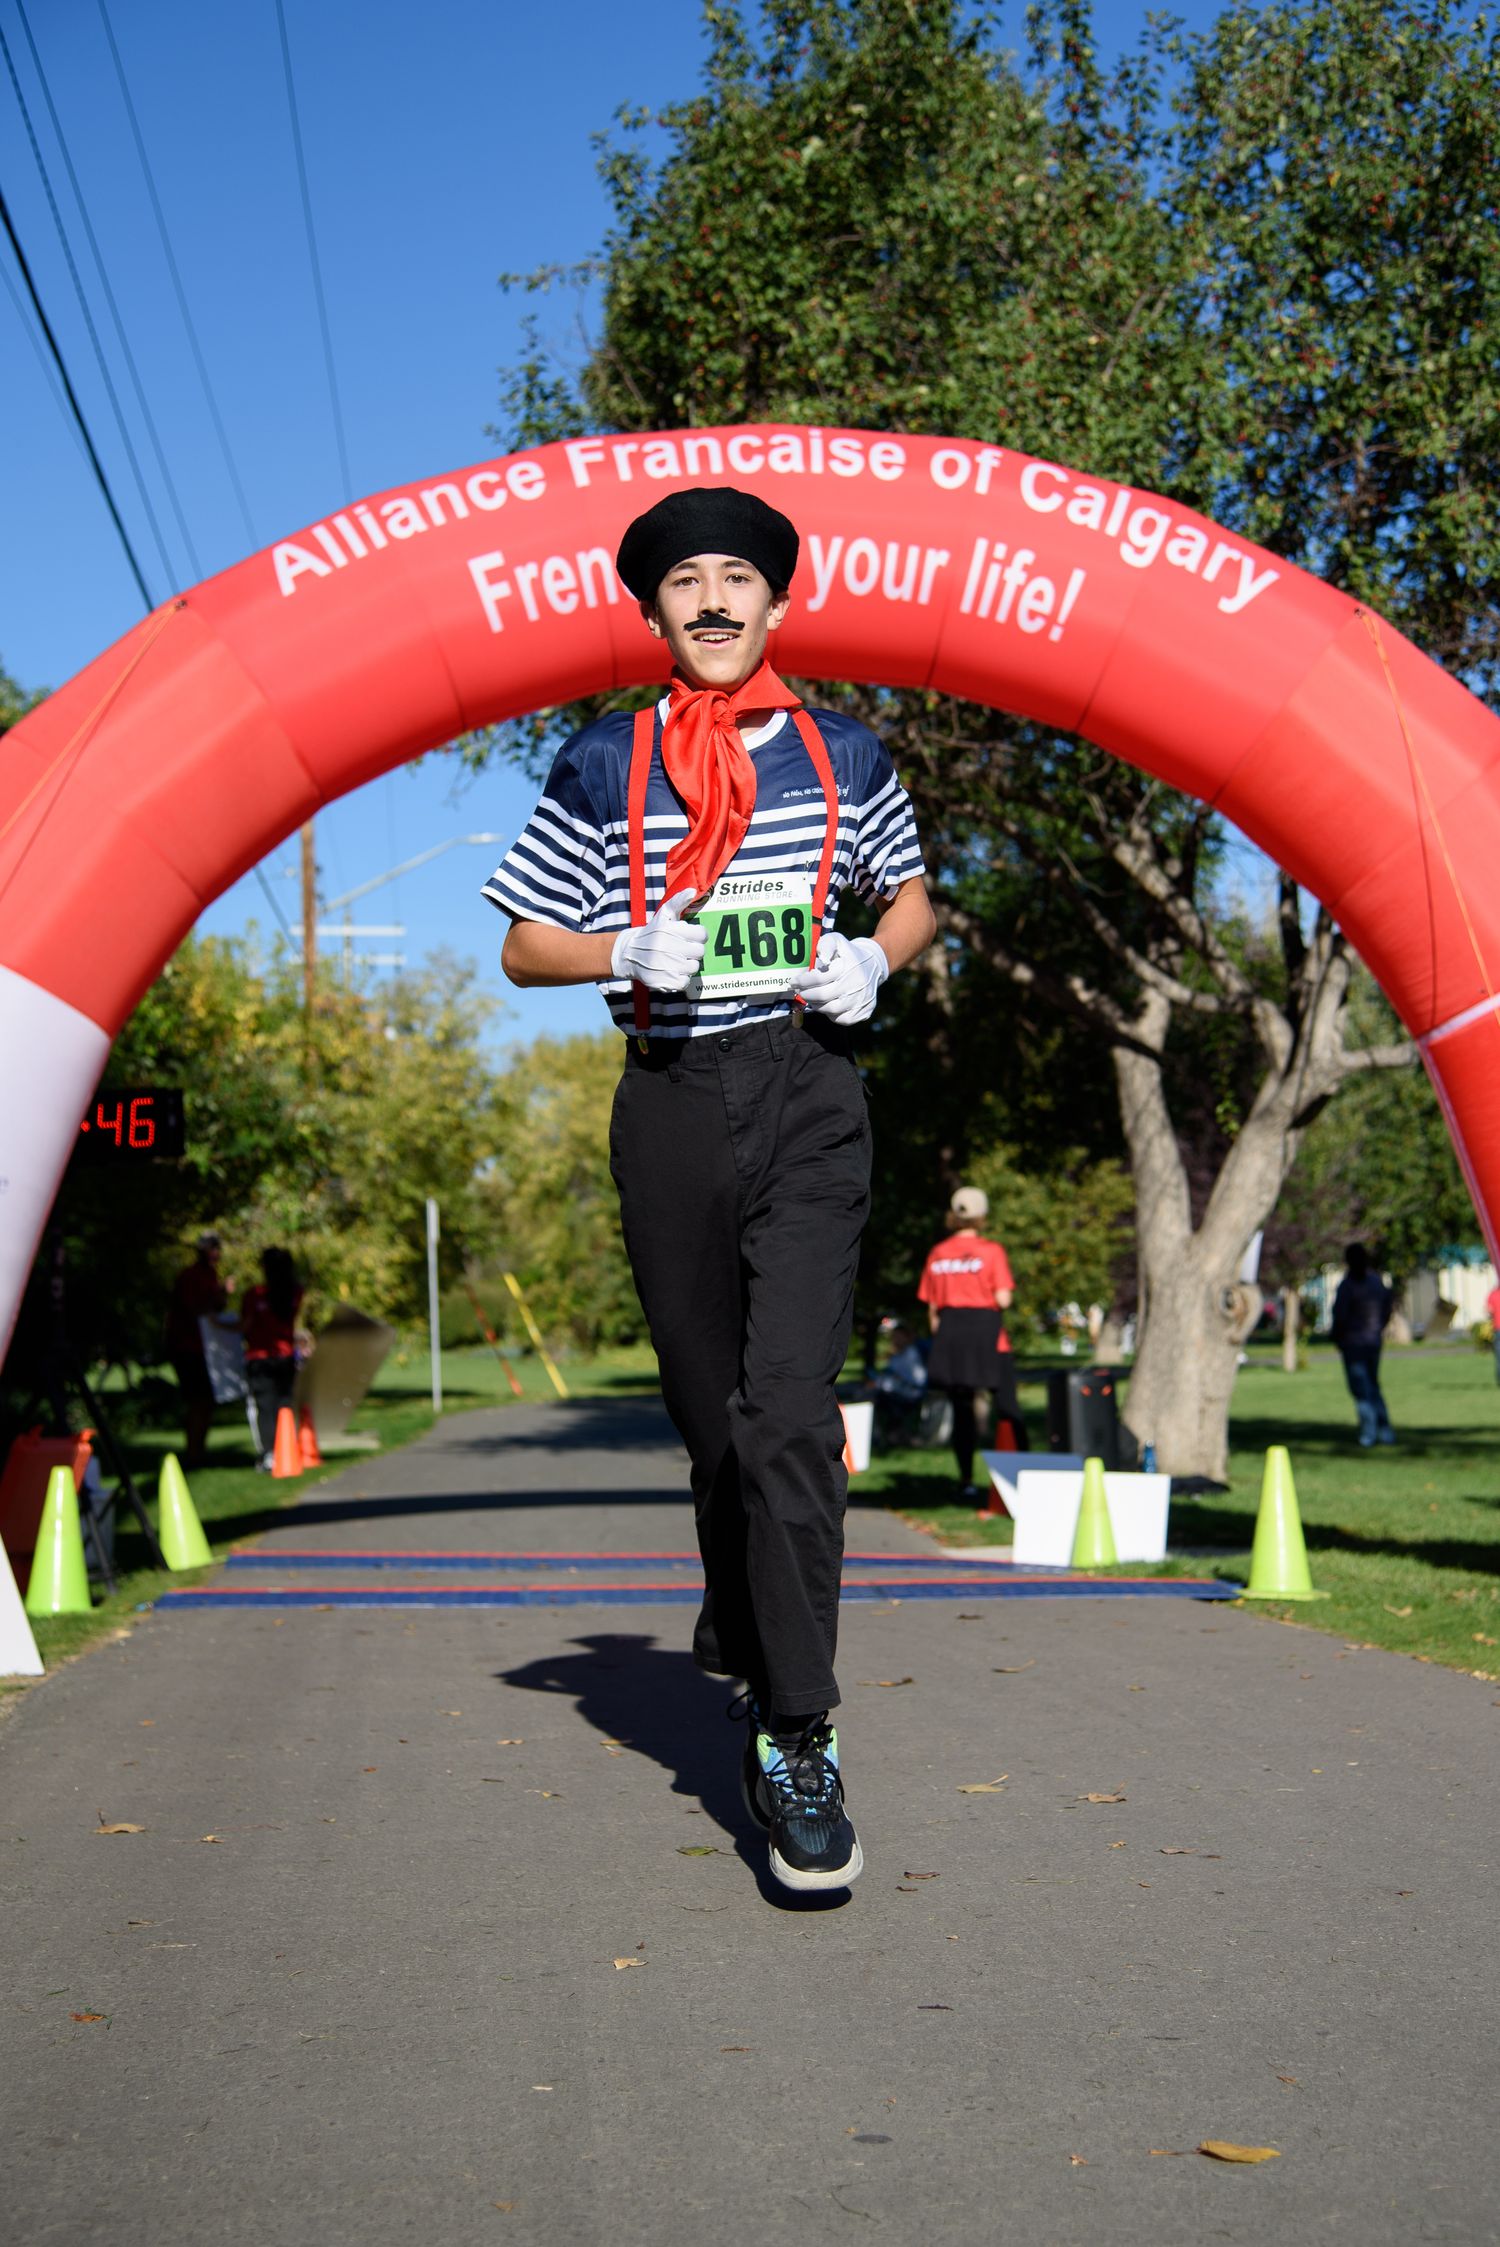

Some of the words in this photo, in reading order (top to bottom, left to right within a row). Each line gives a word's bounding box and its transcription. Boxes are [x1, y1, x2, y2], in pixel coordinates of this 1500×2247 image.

[271, 460, 547, 597] Alliance
[564, 429, 907, 488] Francaise
[929, 447, 1004, 496] of
[1019, 461, 1282, 614] Calgary
[466, 546, 641, 634] Fren
[806, 534, 951, 613] your
[959, 536, 1087, 642] life!
[716, 892, 761, 904] RUNNING
[765, 890, 793, 899] STORE
[719, 880, 784, 896] Strides
[688, 908, 806, 971] 468
[695, 977, 792, 992] www.stridesrunning.c
